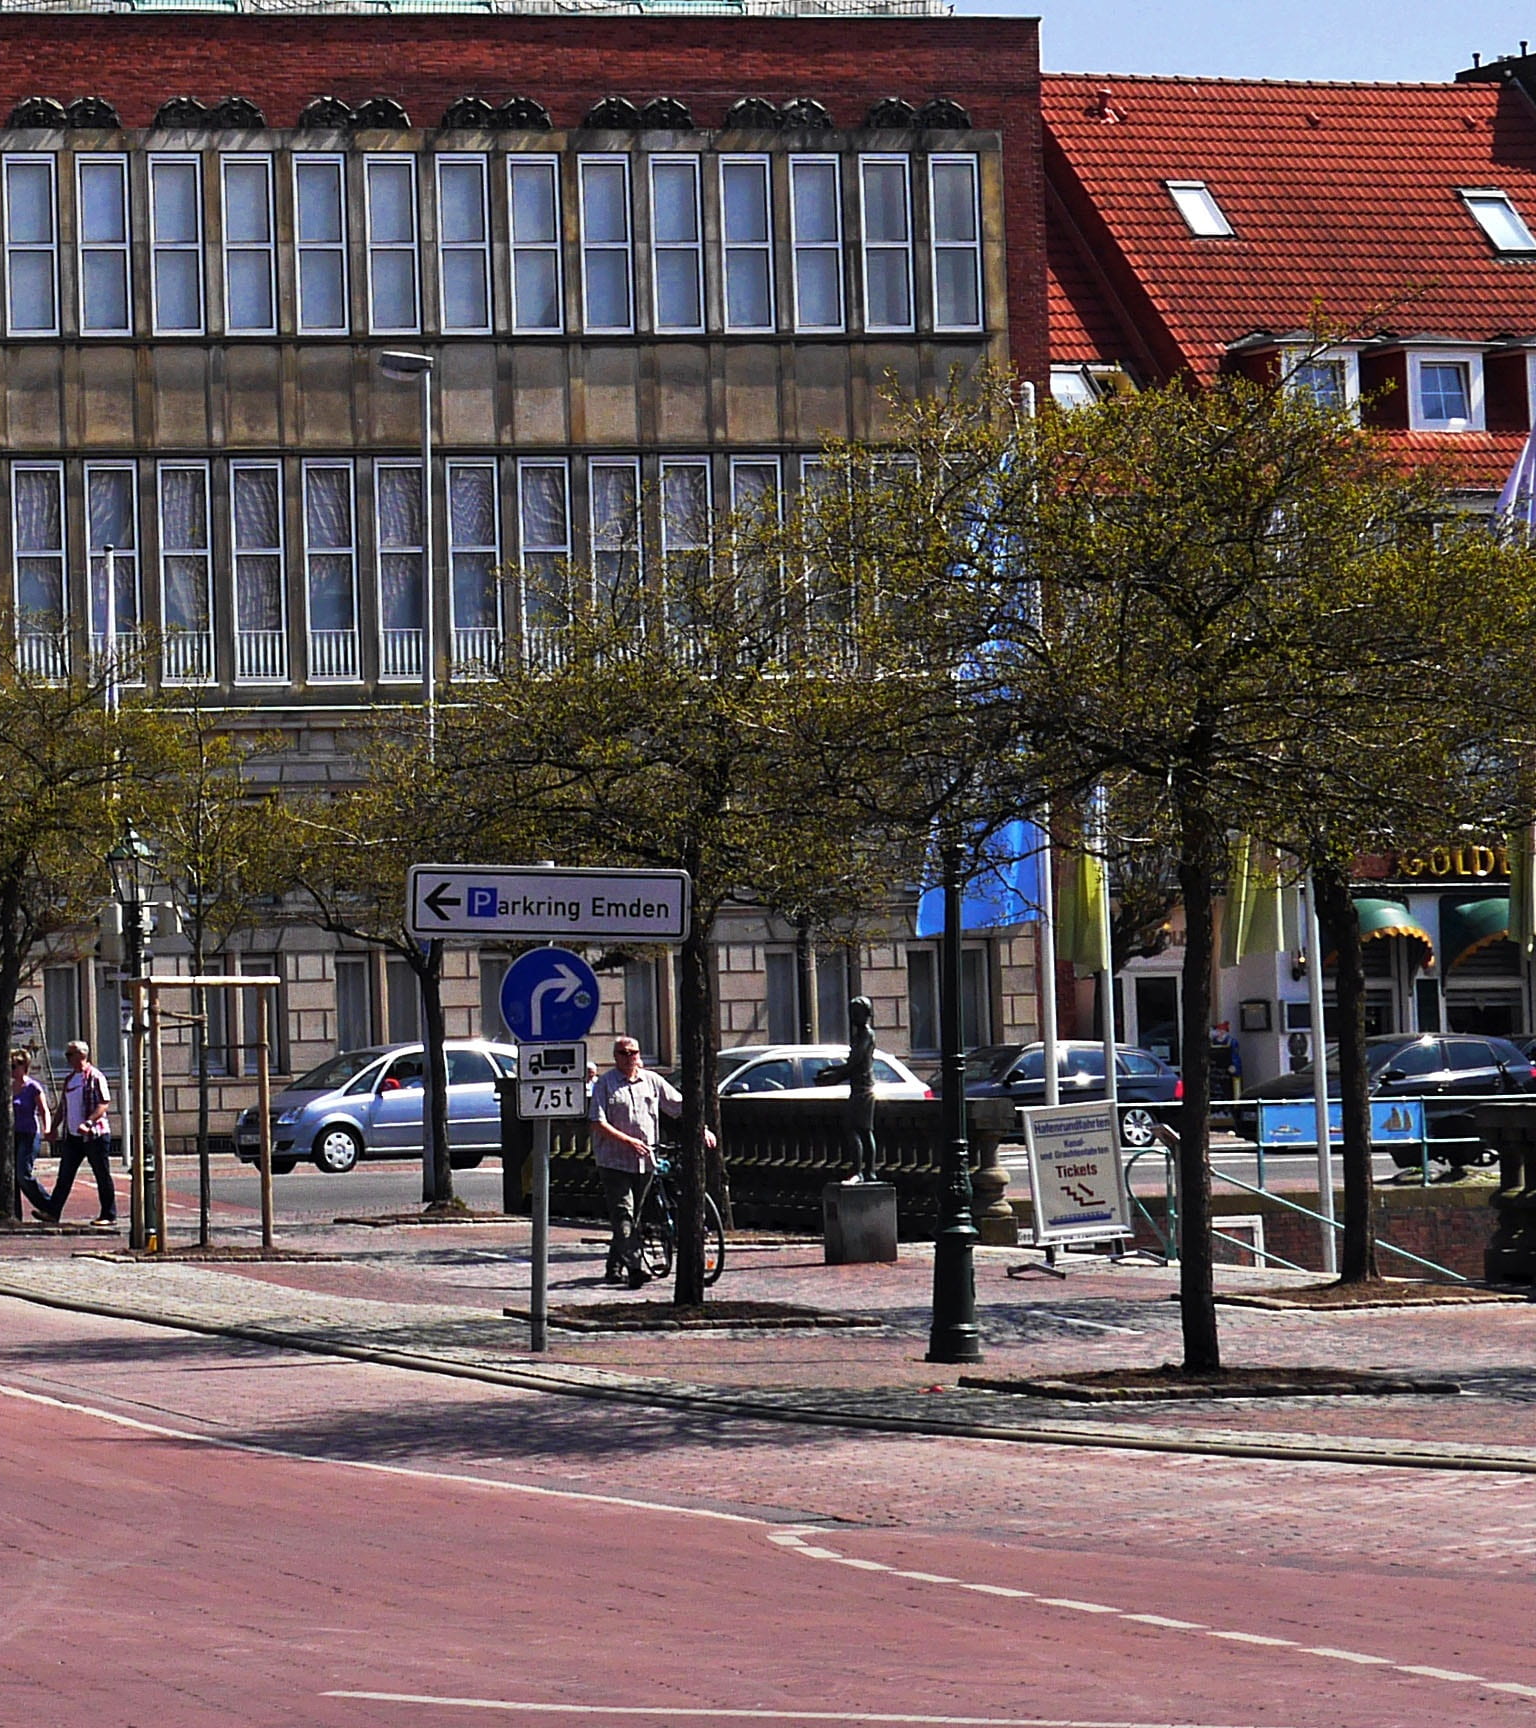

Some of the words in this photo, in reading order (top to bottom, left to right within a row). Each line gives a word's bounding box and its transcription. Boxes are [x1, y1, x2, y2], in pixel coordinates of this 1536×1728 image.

[473, 890, 580, 922] Parkring
[592, 897, 669, 918] Emden
[1034, 1117, 1110, 1135] Hafenrundfahrten
[1055, 1163, 1098, 1179] Tickets
